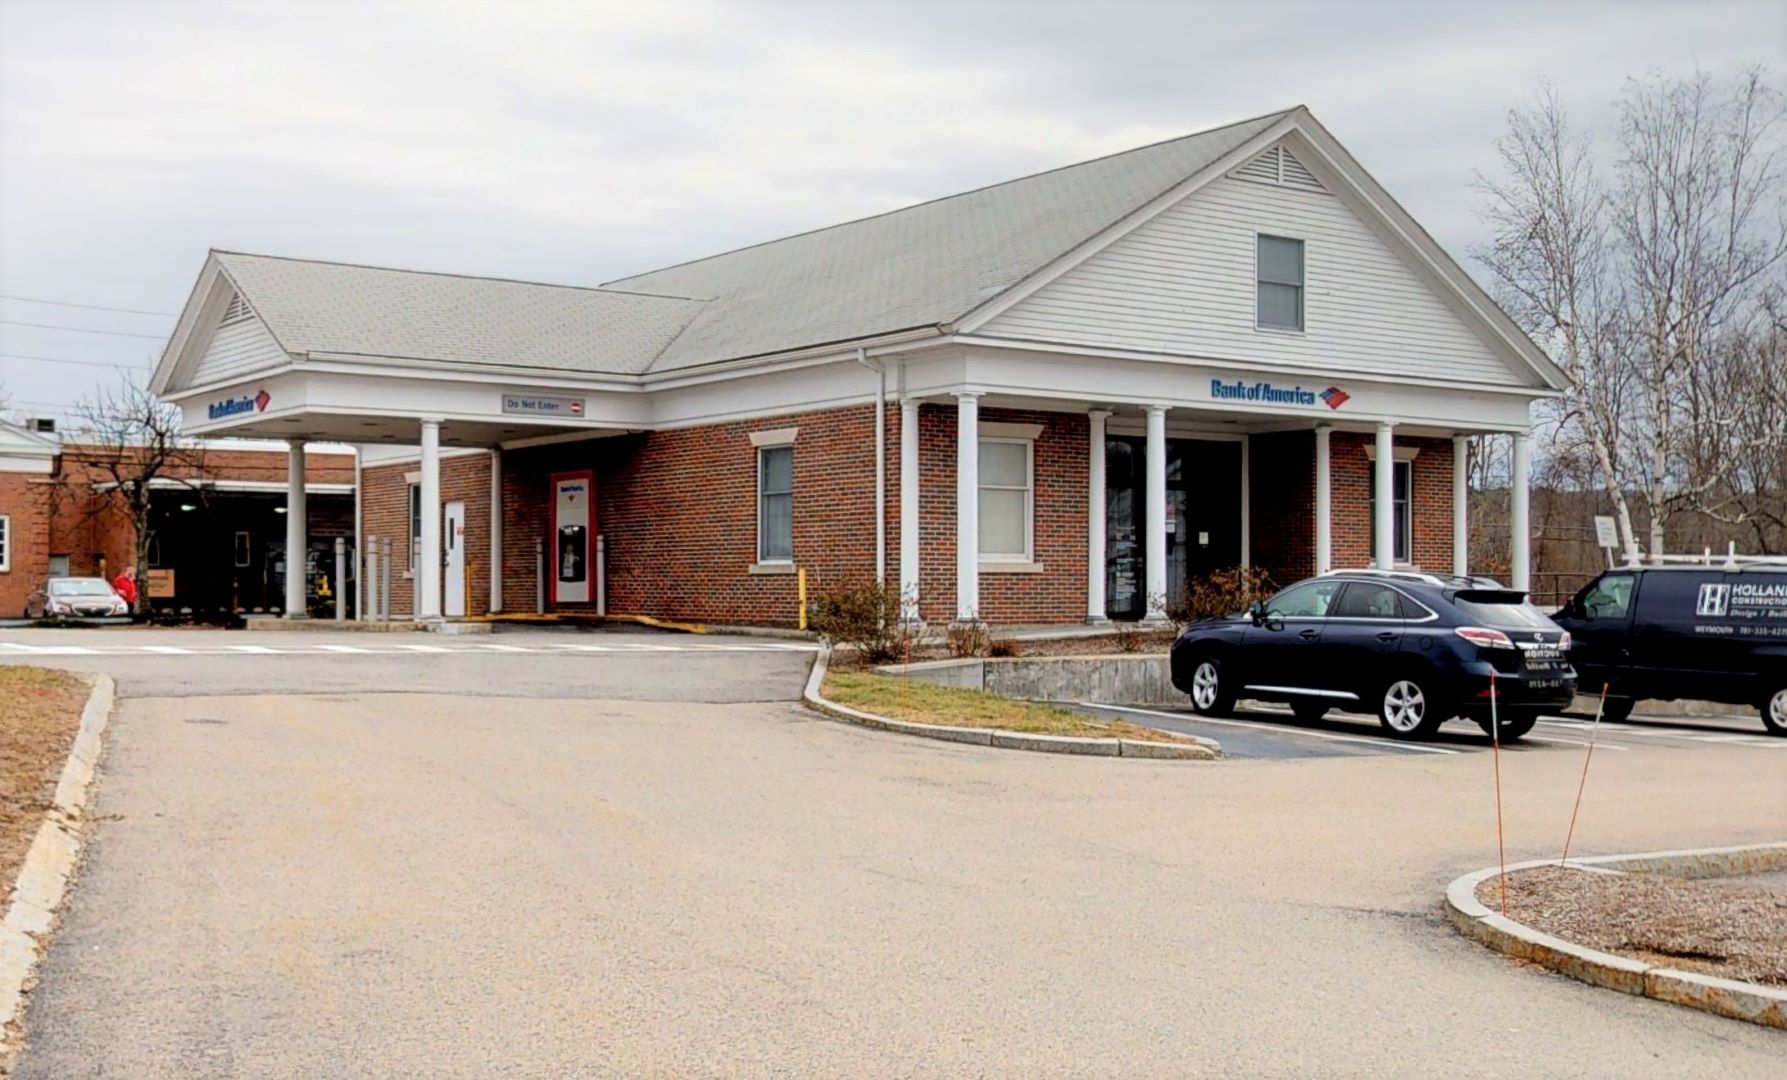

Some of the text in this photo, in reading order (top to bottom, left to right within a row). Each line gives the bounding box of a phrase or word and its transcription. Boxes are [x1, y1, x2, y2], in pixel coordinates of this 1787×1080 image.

[1211, 379, 1316, 405] Bank of America
[508, 400, 559, 410] Do Not Enter
[1732, 584, 1787, 596] HOLLAN
[1731, 597, 1787, 605] CONSTRUCTIO
[1730, 609, 1758, 618] Design
[1767, 609, 1787, 618] Buil
